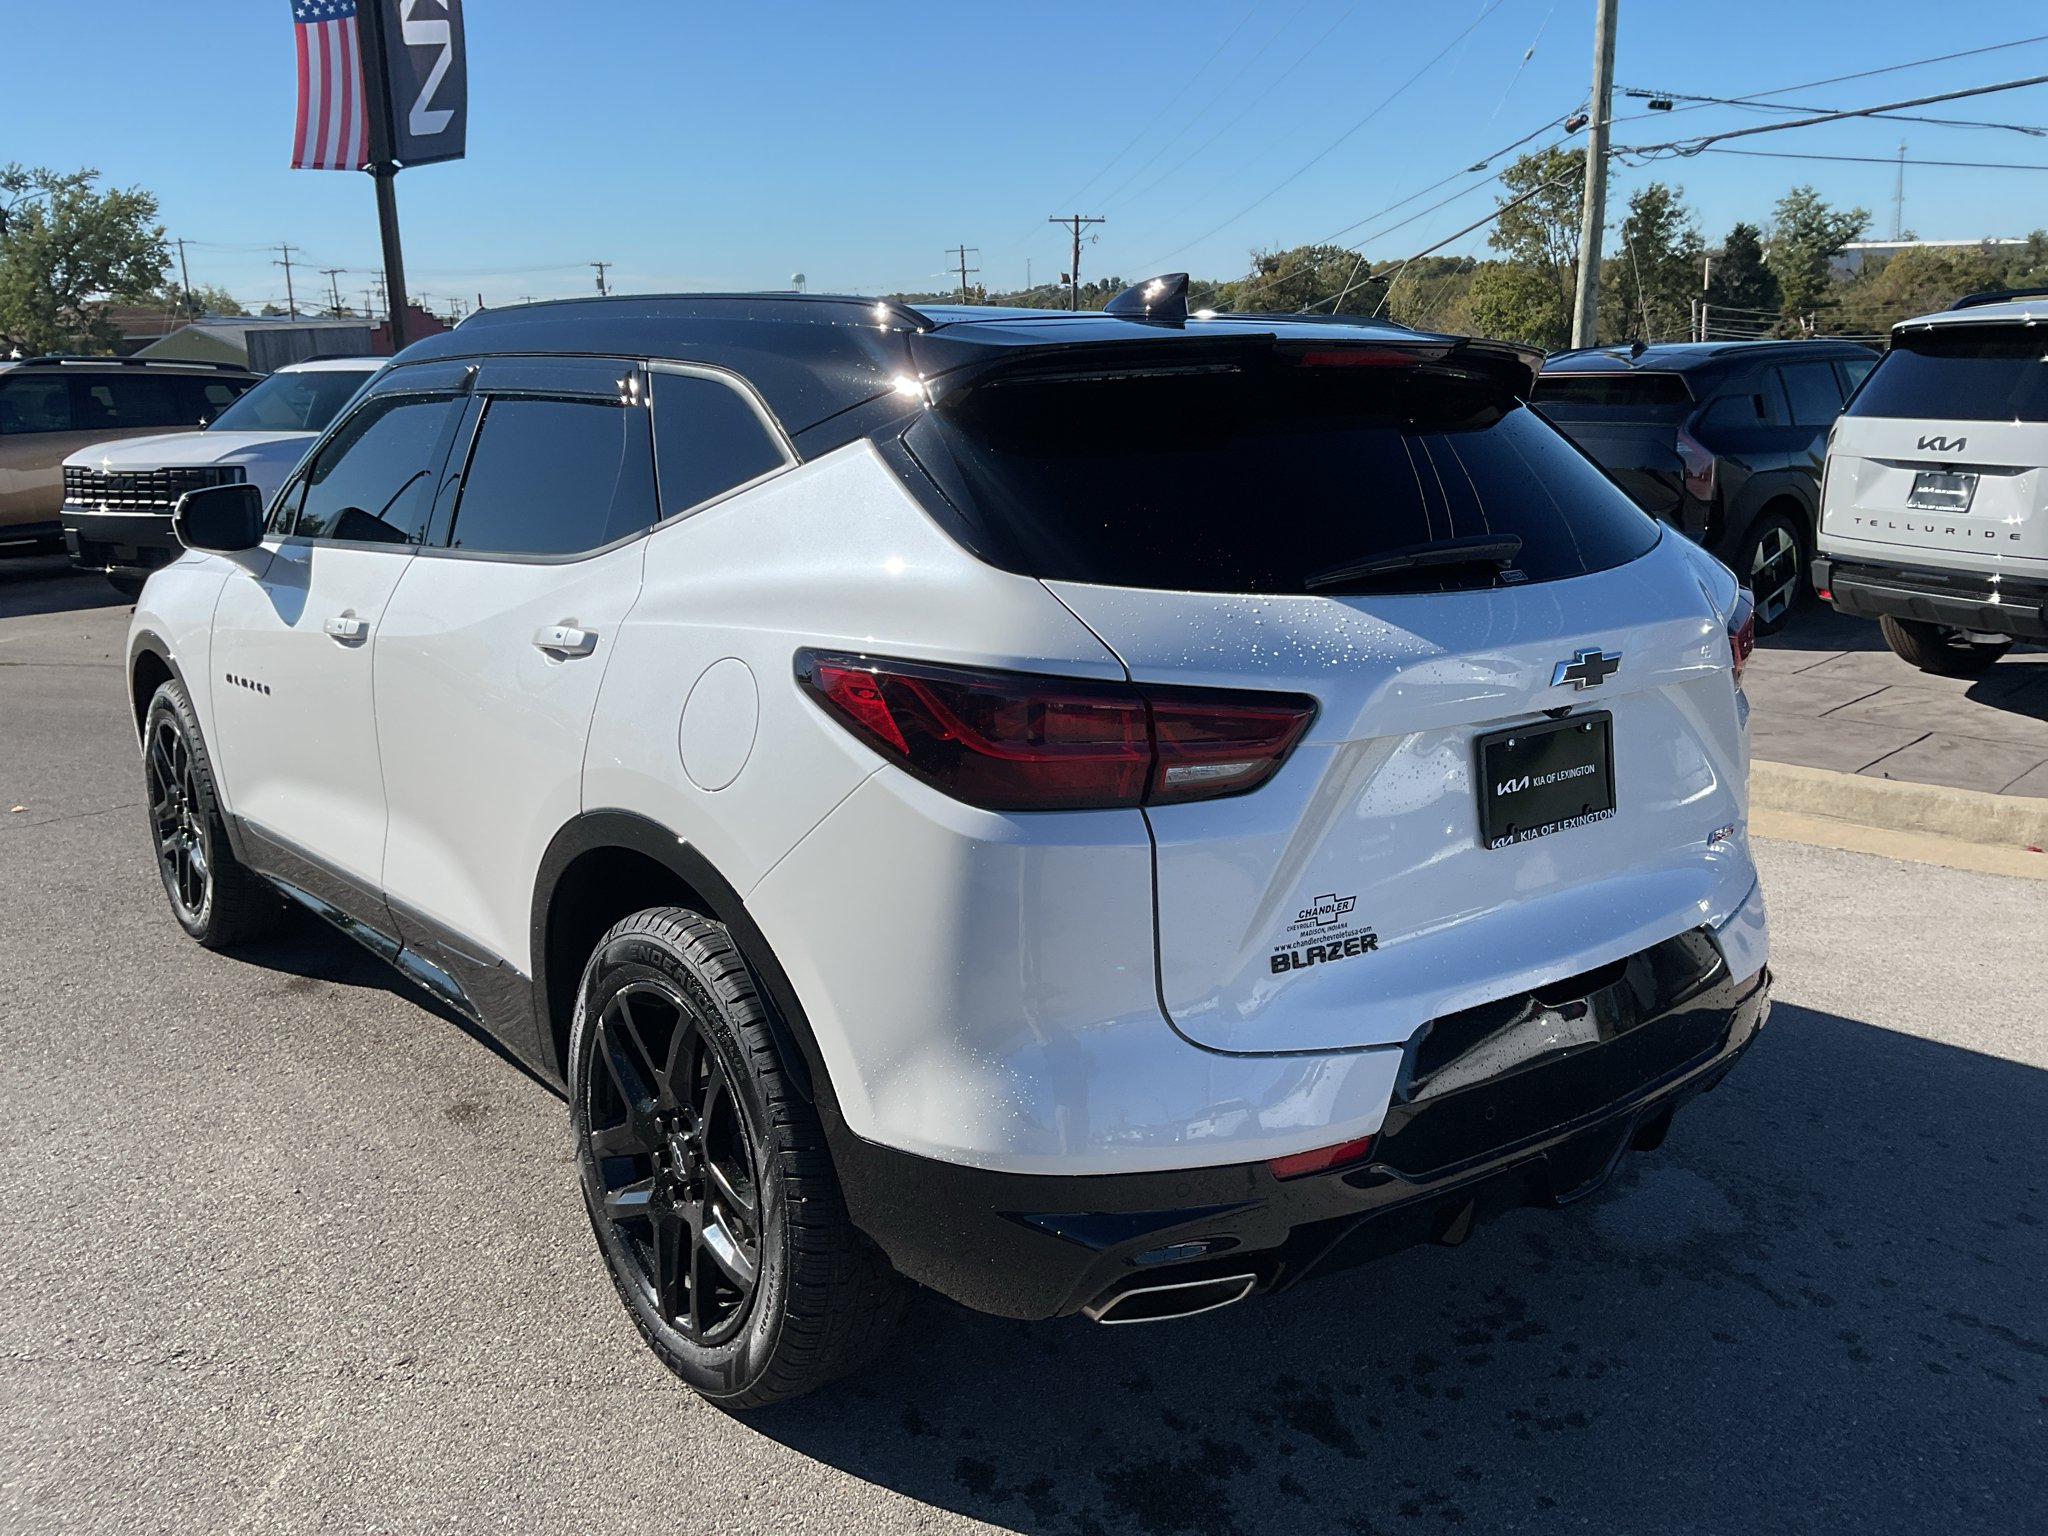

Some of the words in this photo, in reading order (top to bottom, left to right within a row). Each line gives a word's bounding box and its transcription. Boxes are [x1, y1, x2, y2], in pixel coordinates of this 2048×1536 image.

[1917, 435, 1967, 452] KIA
[1855, 517, 2021, 541] TELLURIDE
[1497, 775, 1529, 796] KIA
[1533, 777, 1546, 787] KIA
[1546, 773, 1556, 783] OF
[1557, 764, 1595, 782] LEXINGTON
[1520, 828, 1538, 842] KIA
[1541, 823, 1555, 836] OF
[1557, 807, 1616, 831] LEXINGTON
[1298, 901, 1349, 919] CHANDLER
[1286, 921, 1315, 933] CHEVROLET
[1327, 922, 1348, 933] INDIANA
[1270, 933, 1379, 974] BLAZER
